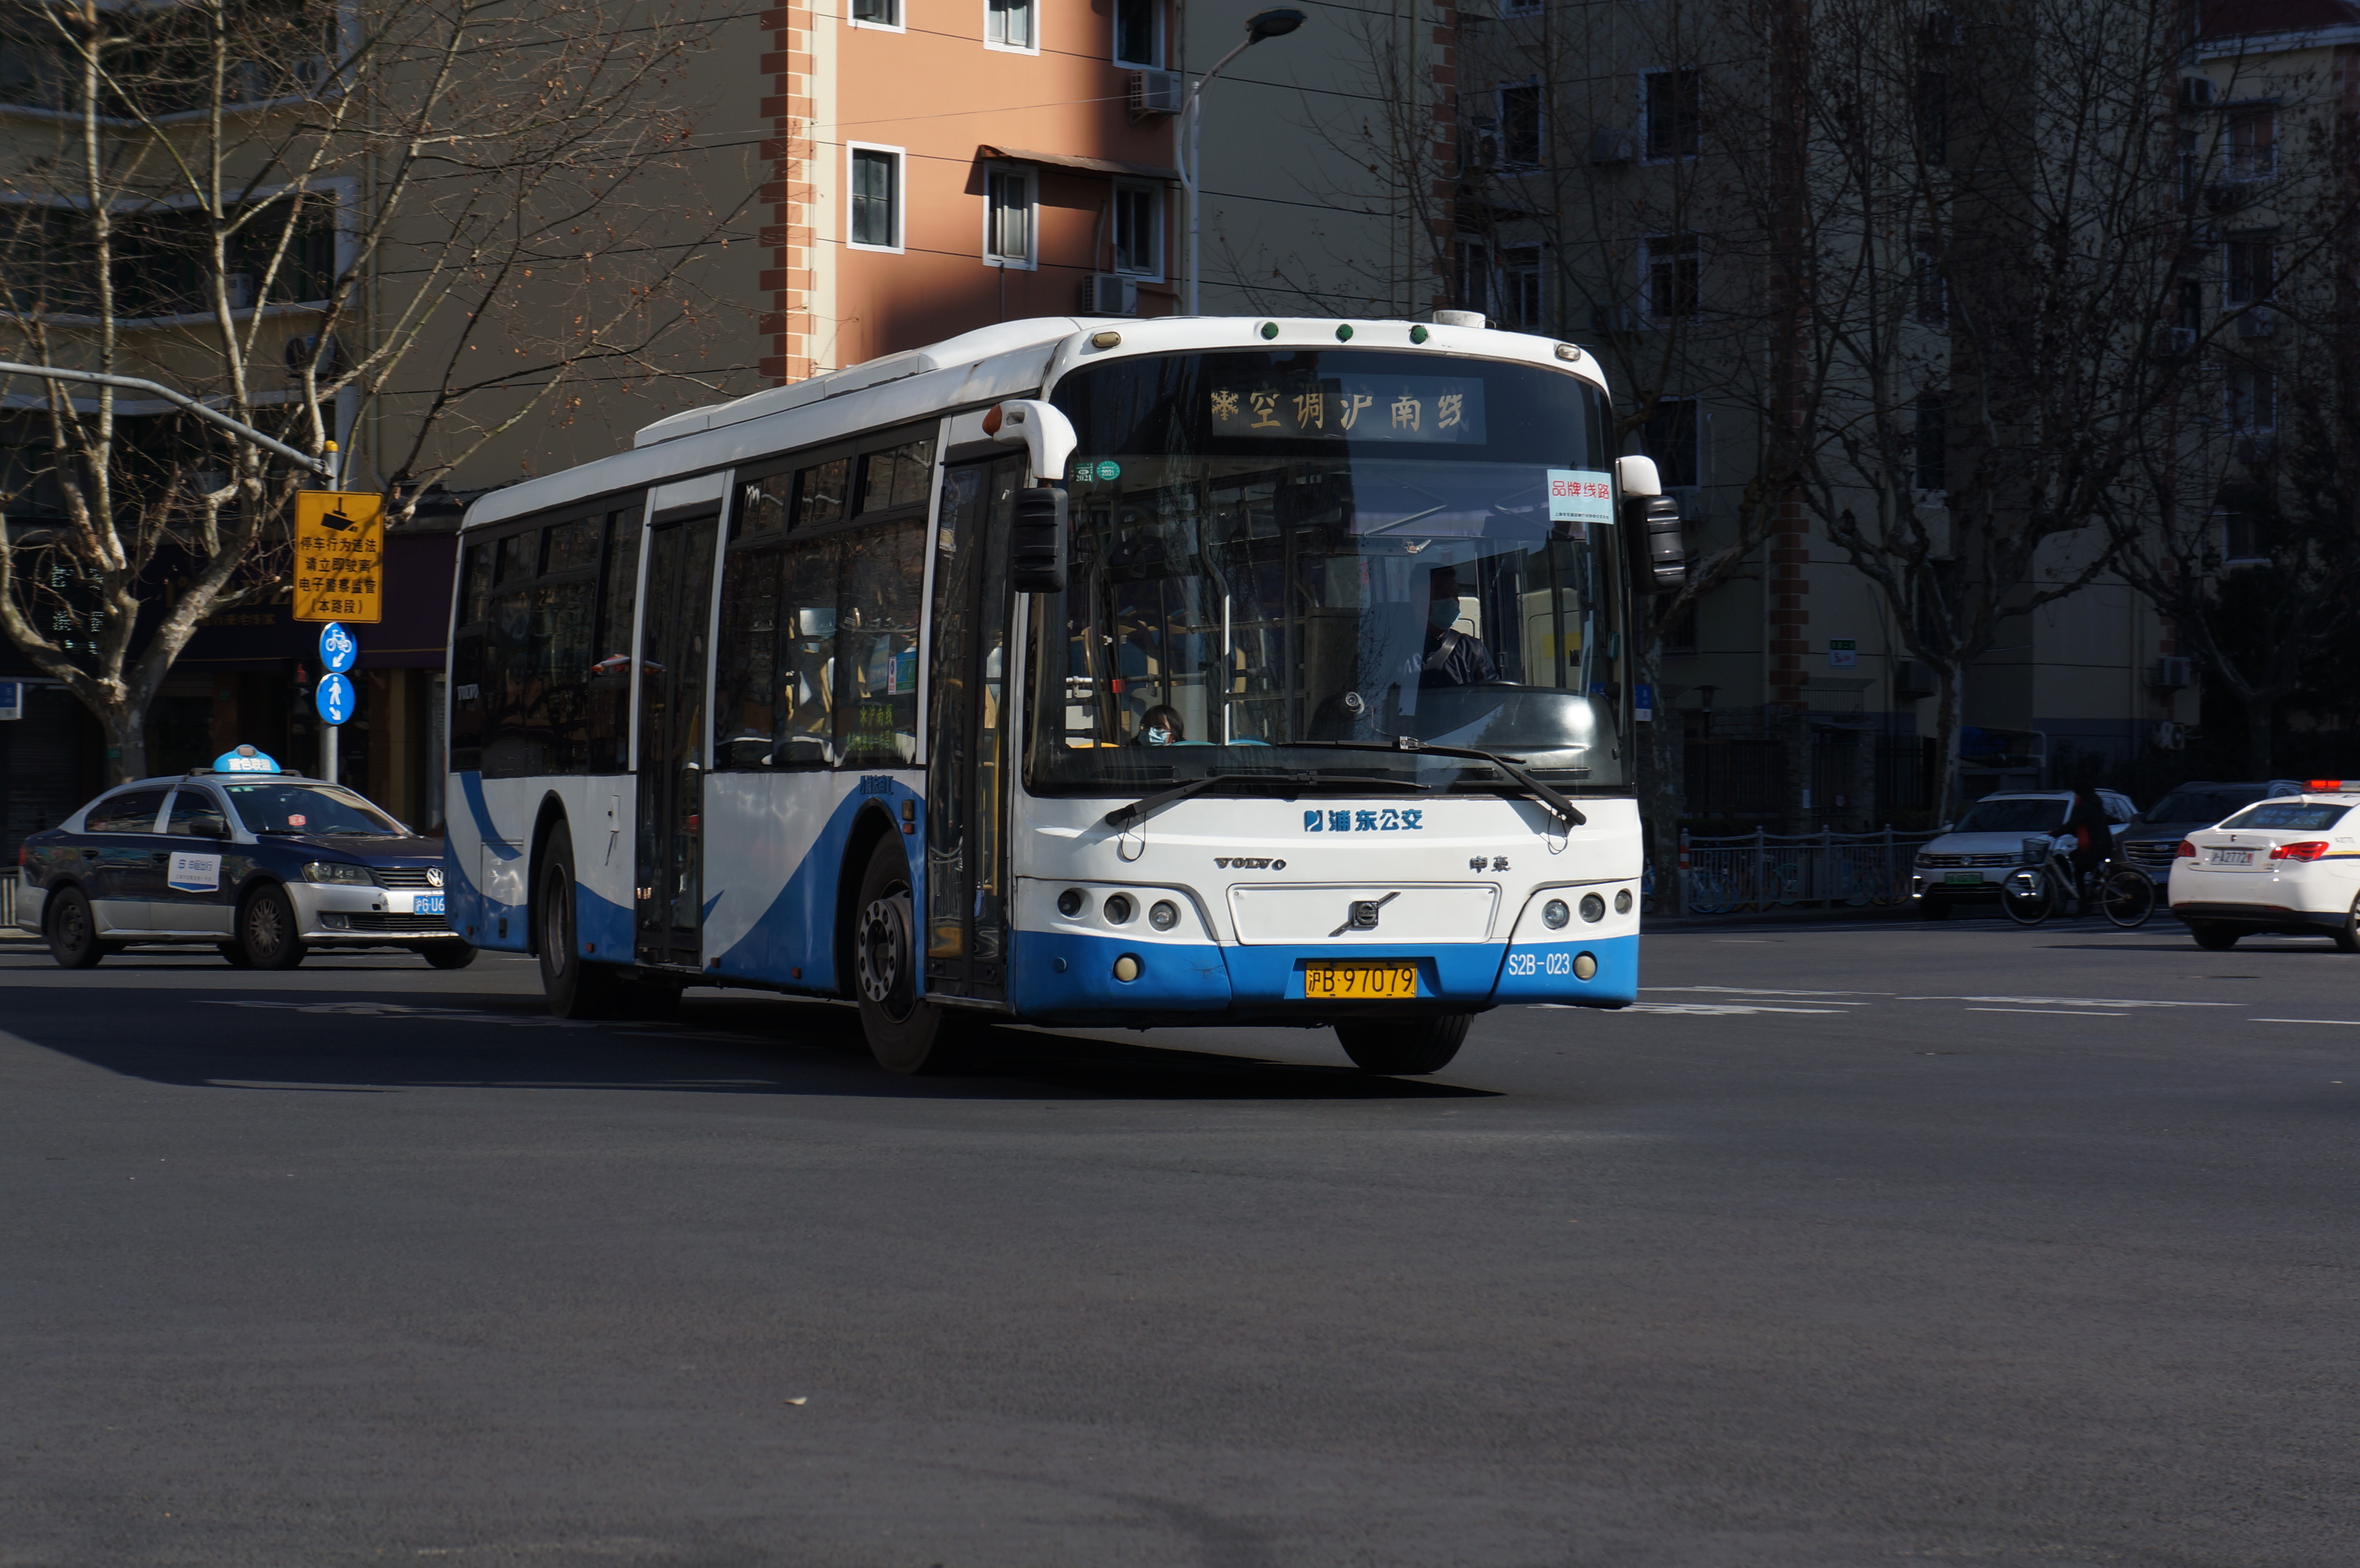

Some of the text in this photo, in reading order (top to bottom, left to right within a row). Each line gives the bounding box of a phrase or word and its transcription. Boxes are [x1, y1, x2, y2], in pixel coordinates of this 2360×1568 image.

[1250, 383, 1468, 432] 空调沪南线
[1552, 480, 1610, 499] 品牌线路
[300, 536, 377, 552] 停车行为违法
[305, 558, 371, 573] 请立即驶离
[299, 577, 376, 594] 电子警察监管
[228, 758, 272, 771] 蓝色联盟
[1328, 808, 1423, 832] 浦东公交
[1213, 857, 1286, 870] VOLVO
[1509, 953, 1570, 975] S2B-023
